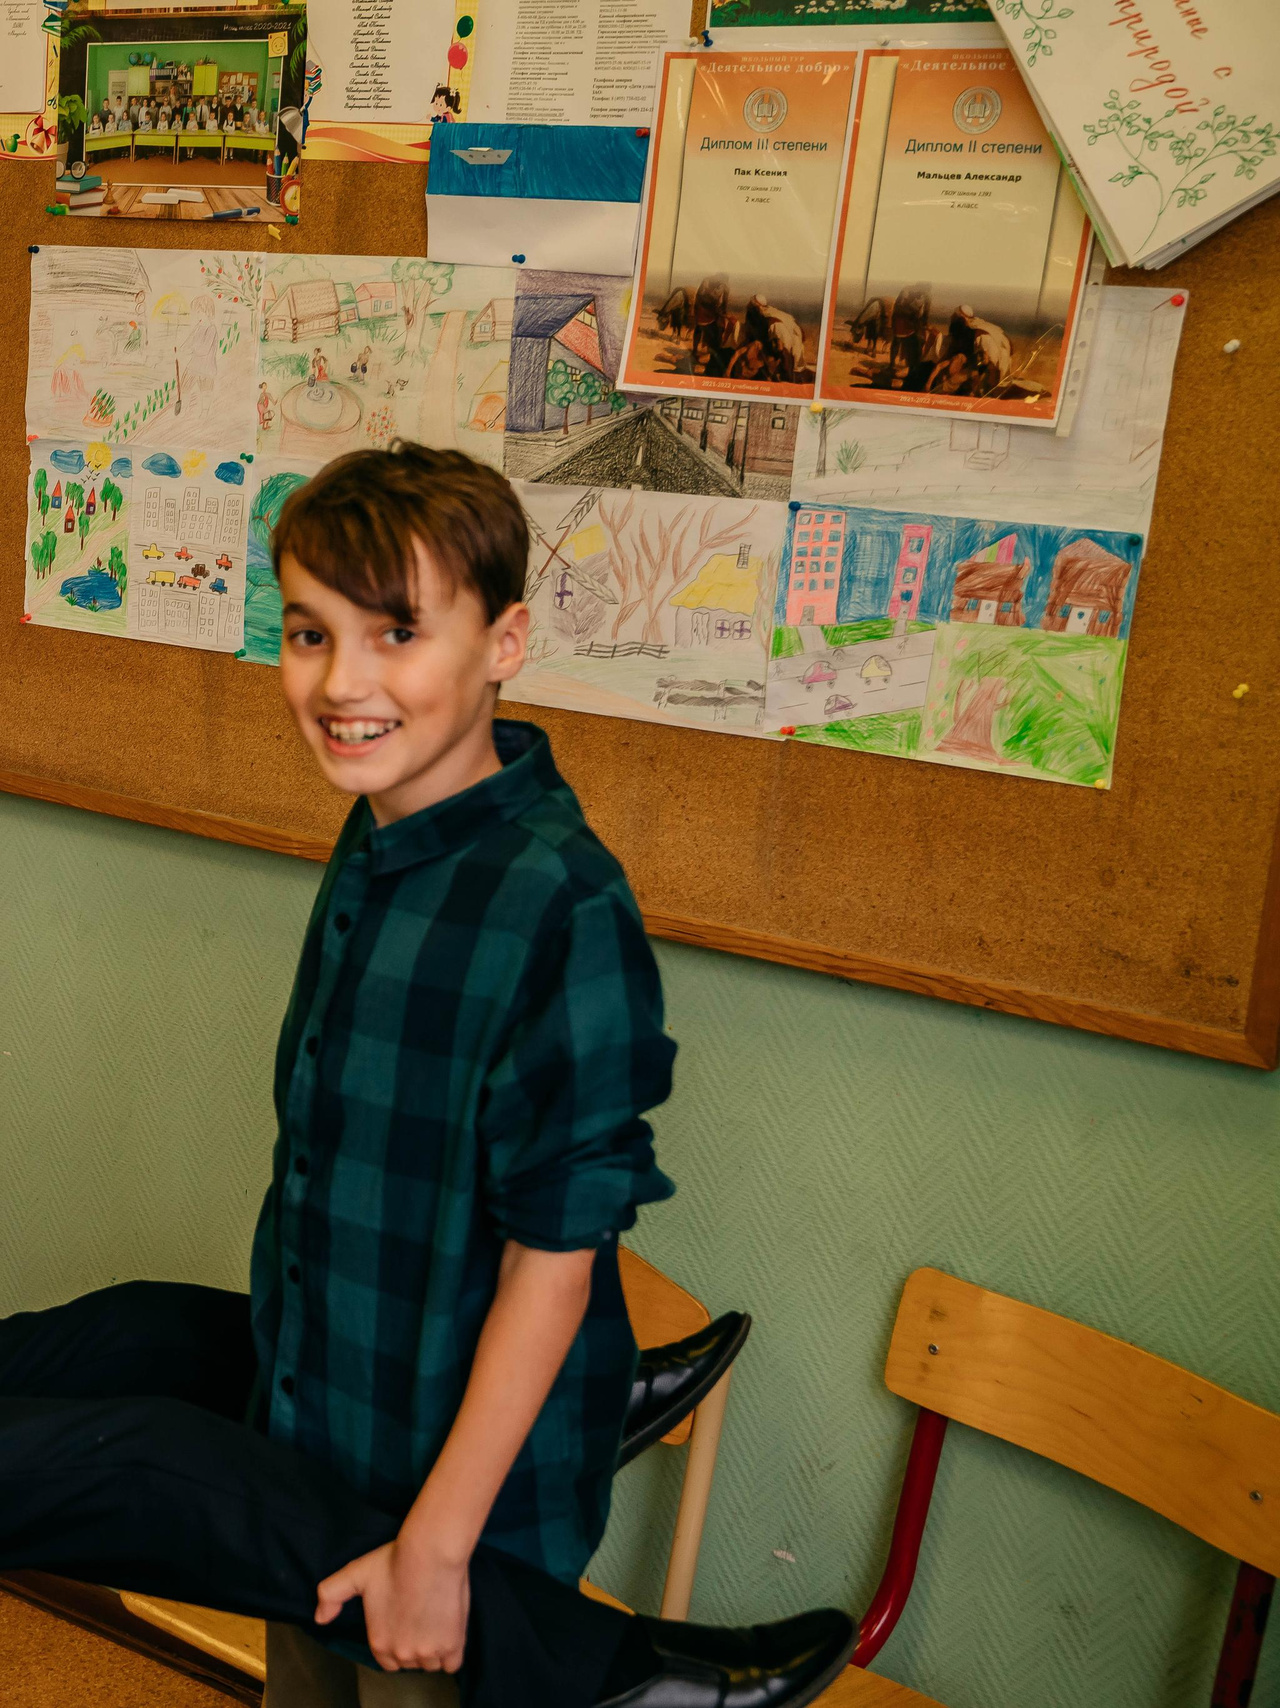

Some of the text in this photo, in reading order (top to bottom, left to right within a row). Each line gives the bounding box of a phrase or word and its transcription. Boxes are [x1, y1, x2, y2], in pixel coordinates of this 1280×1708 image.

[700, 62, 791, 74] «Деятельное
[1213, 66, 1233, 80] с
[700, 136, 828, 152] Диплом III степени
[905, 139, 1042, 154] Диплом II степени
[734, 168, 788, 177] Пак Ксения
[917, 171, 1022, 183] Мальцев Александр
